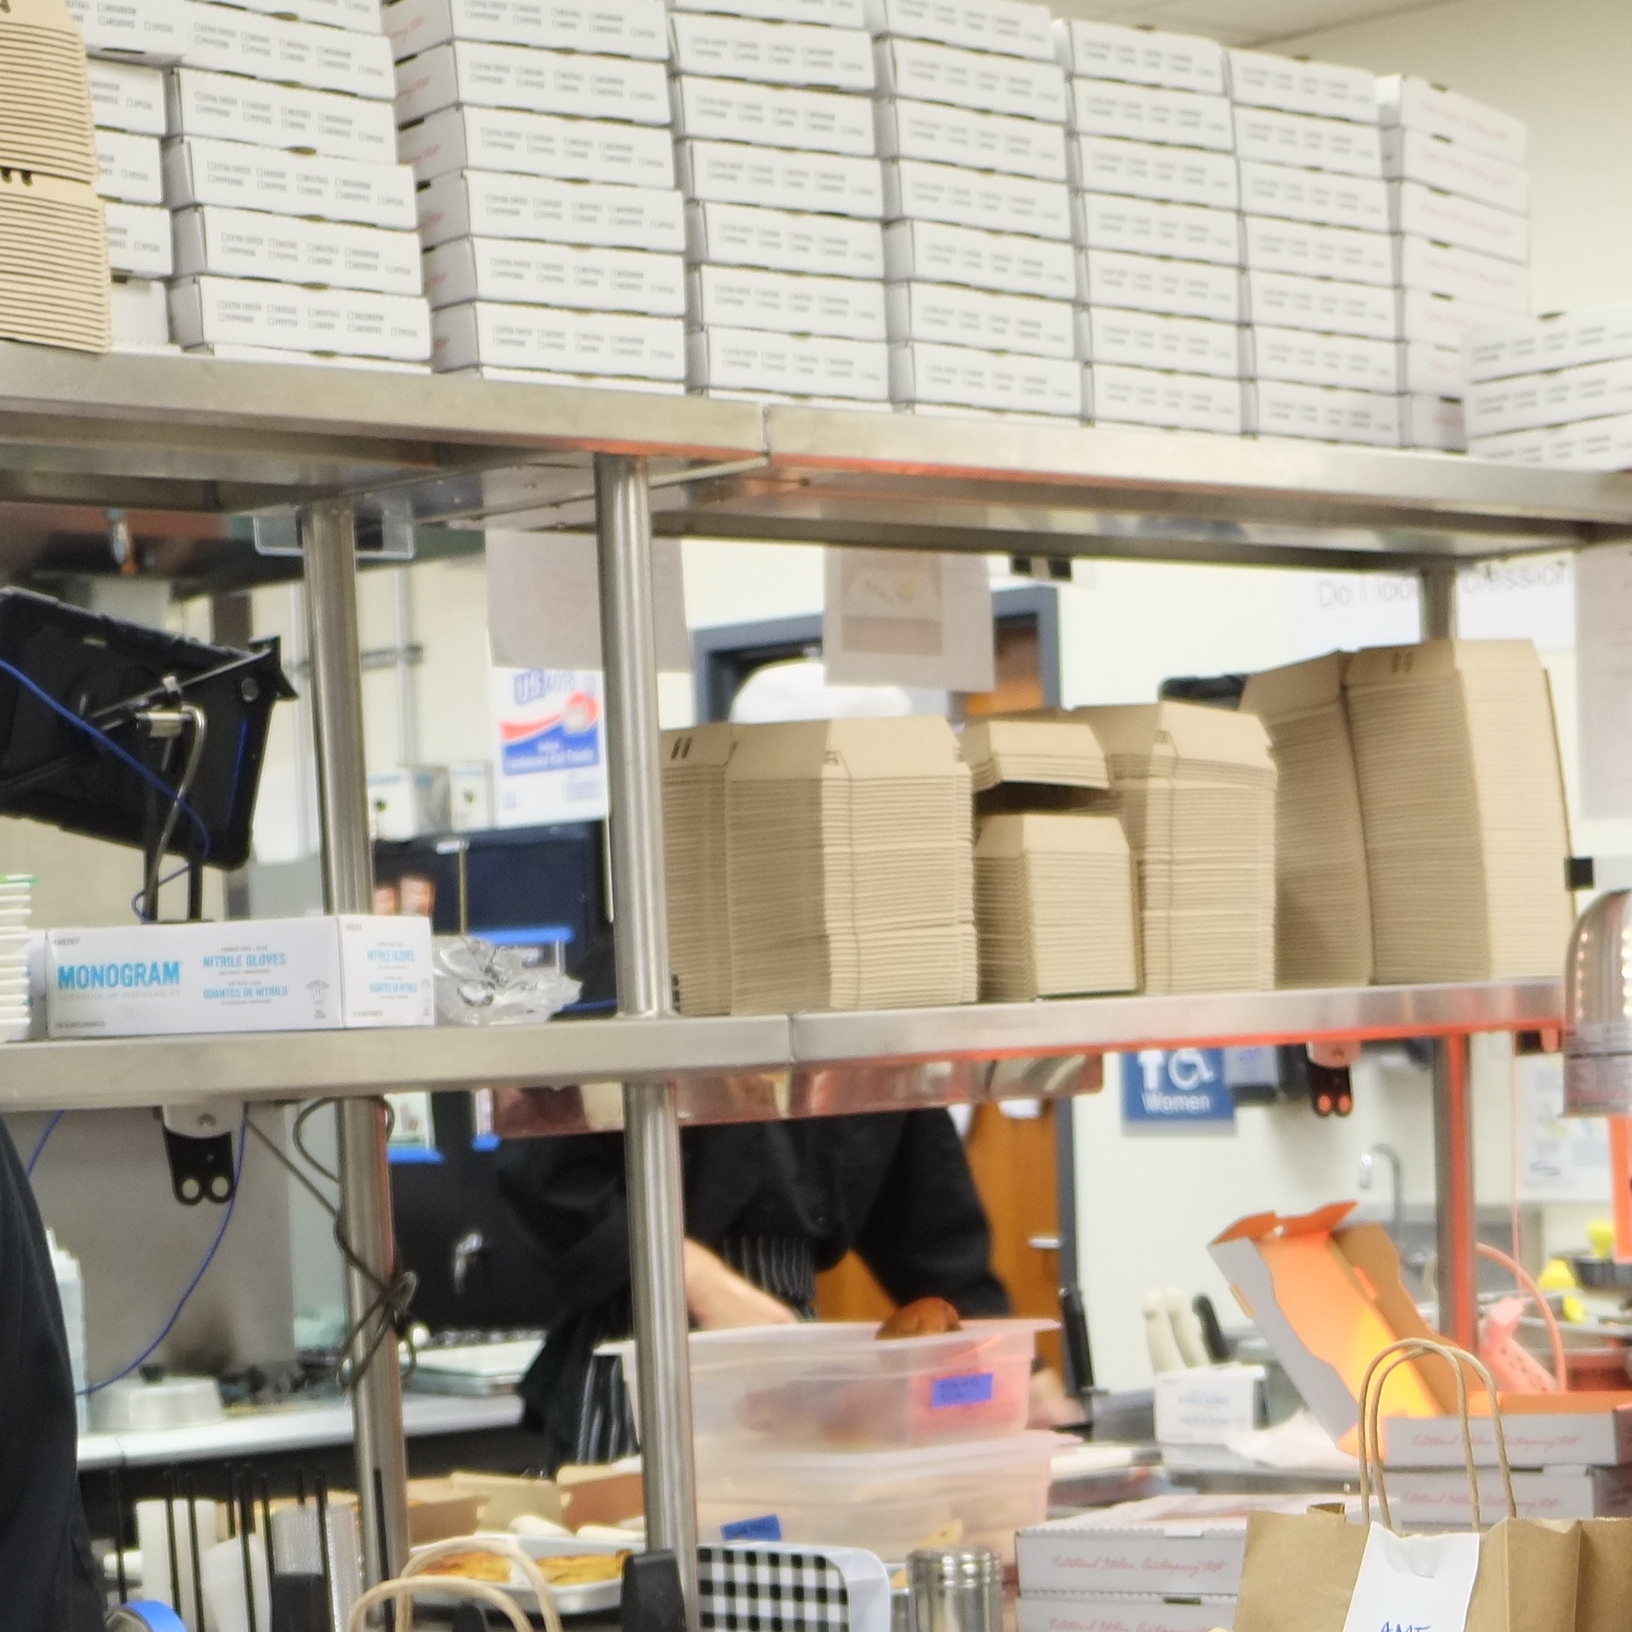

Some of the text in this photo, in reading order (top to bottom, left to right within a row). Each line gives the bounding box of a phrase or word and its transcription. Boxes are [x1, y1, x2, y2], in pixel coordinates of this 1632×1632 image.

[203, 952, 286, 968] NITRILE GLOVES
[57, 961, 180, 990] MONOGRAM
[1141, 1091, 1211, 1112] Women
